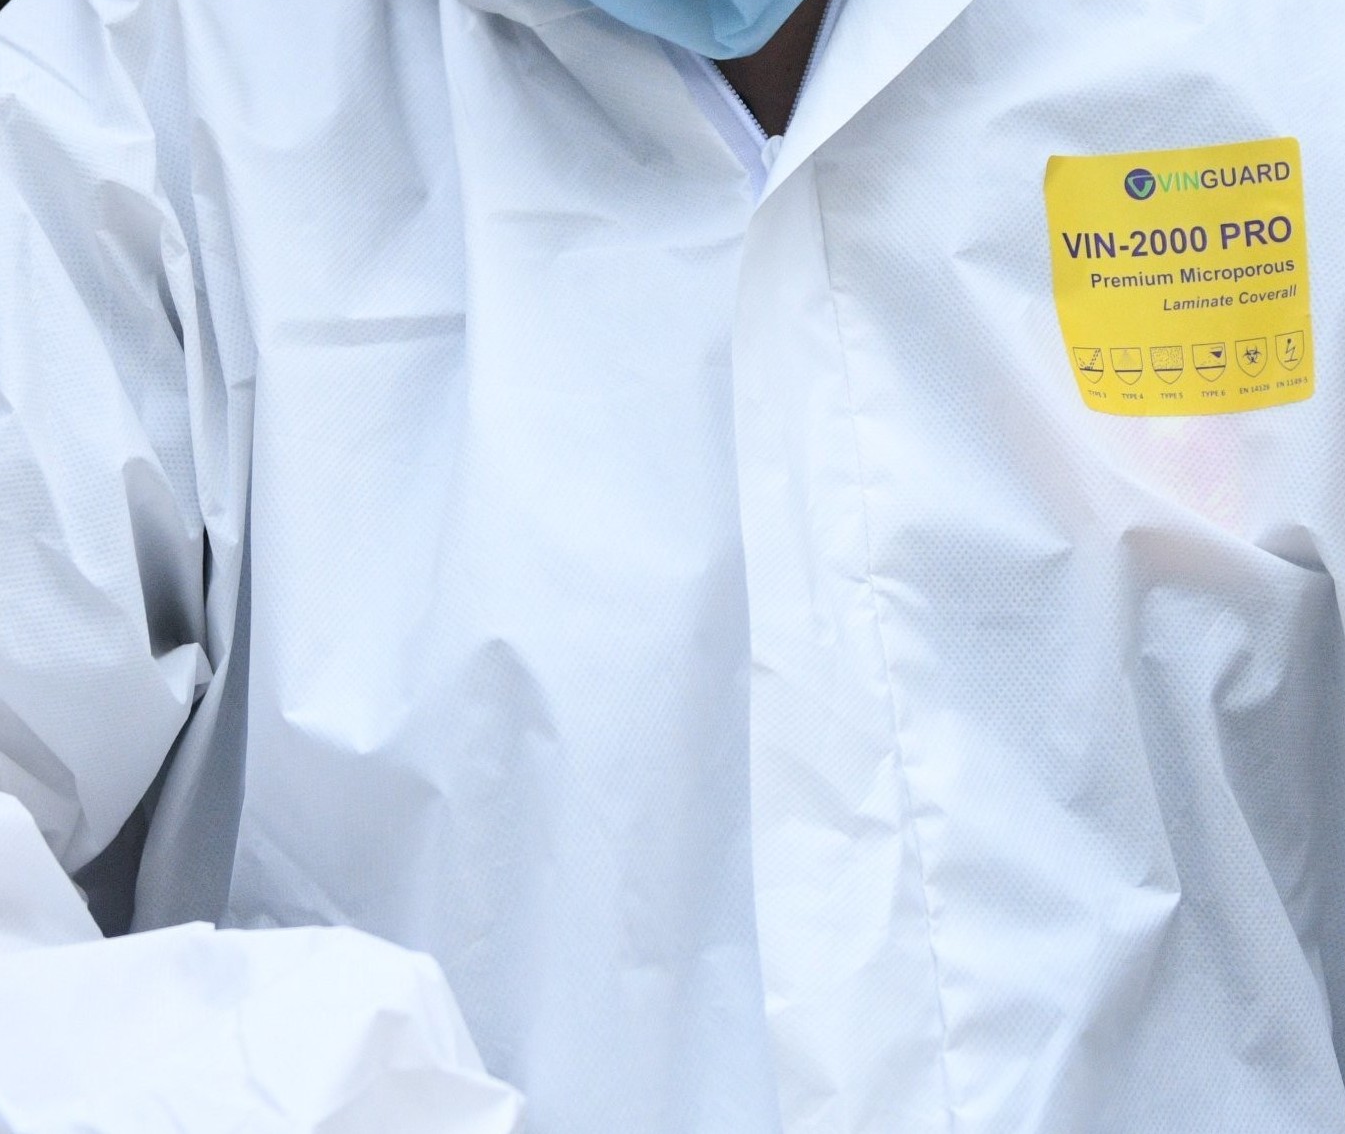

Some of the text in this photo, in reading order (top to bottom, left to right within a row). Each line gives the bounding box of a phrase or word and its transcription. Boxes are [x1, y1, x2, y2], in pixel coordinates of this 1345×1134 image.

[1157, 161, 1291, 194] VINGUARD
[1062, 216, 1292, 259] VIN-2000 PRO
[1091, 259, 1295, 288] Premium Microporous
[1163, 285, 1297, 311] Laminate Coverall
